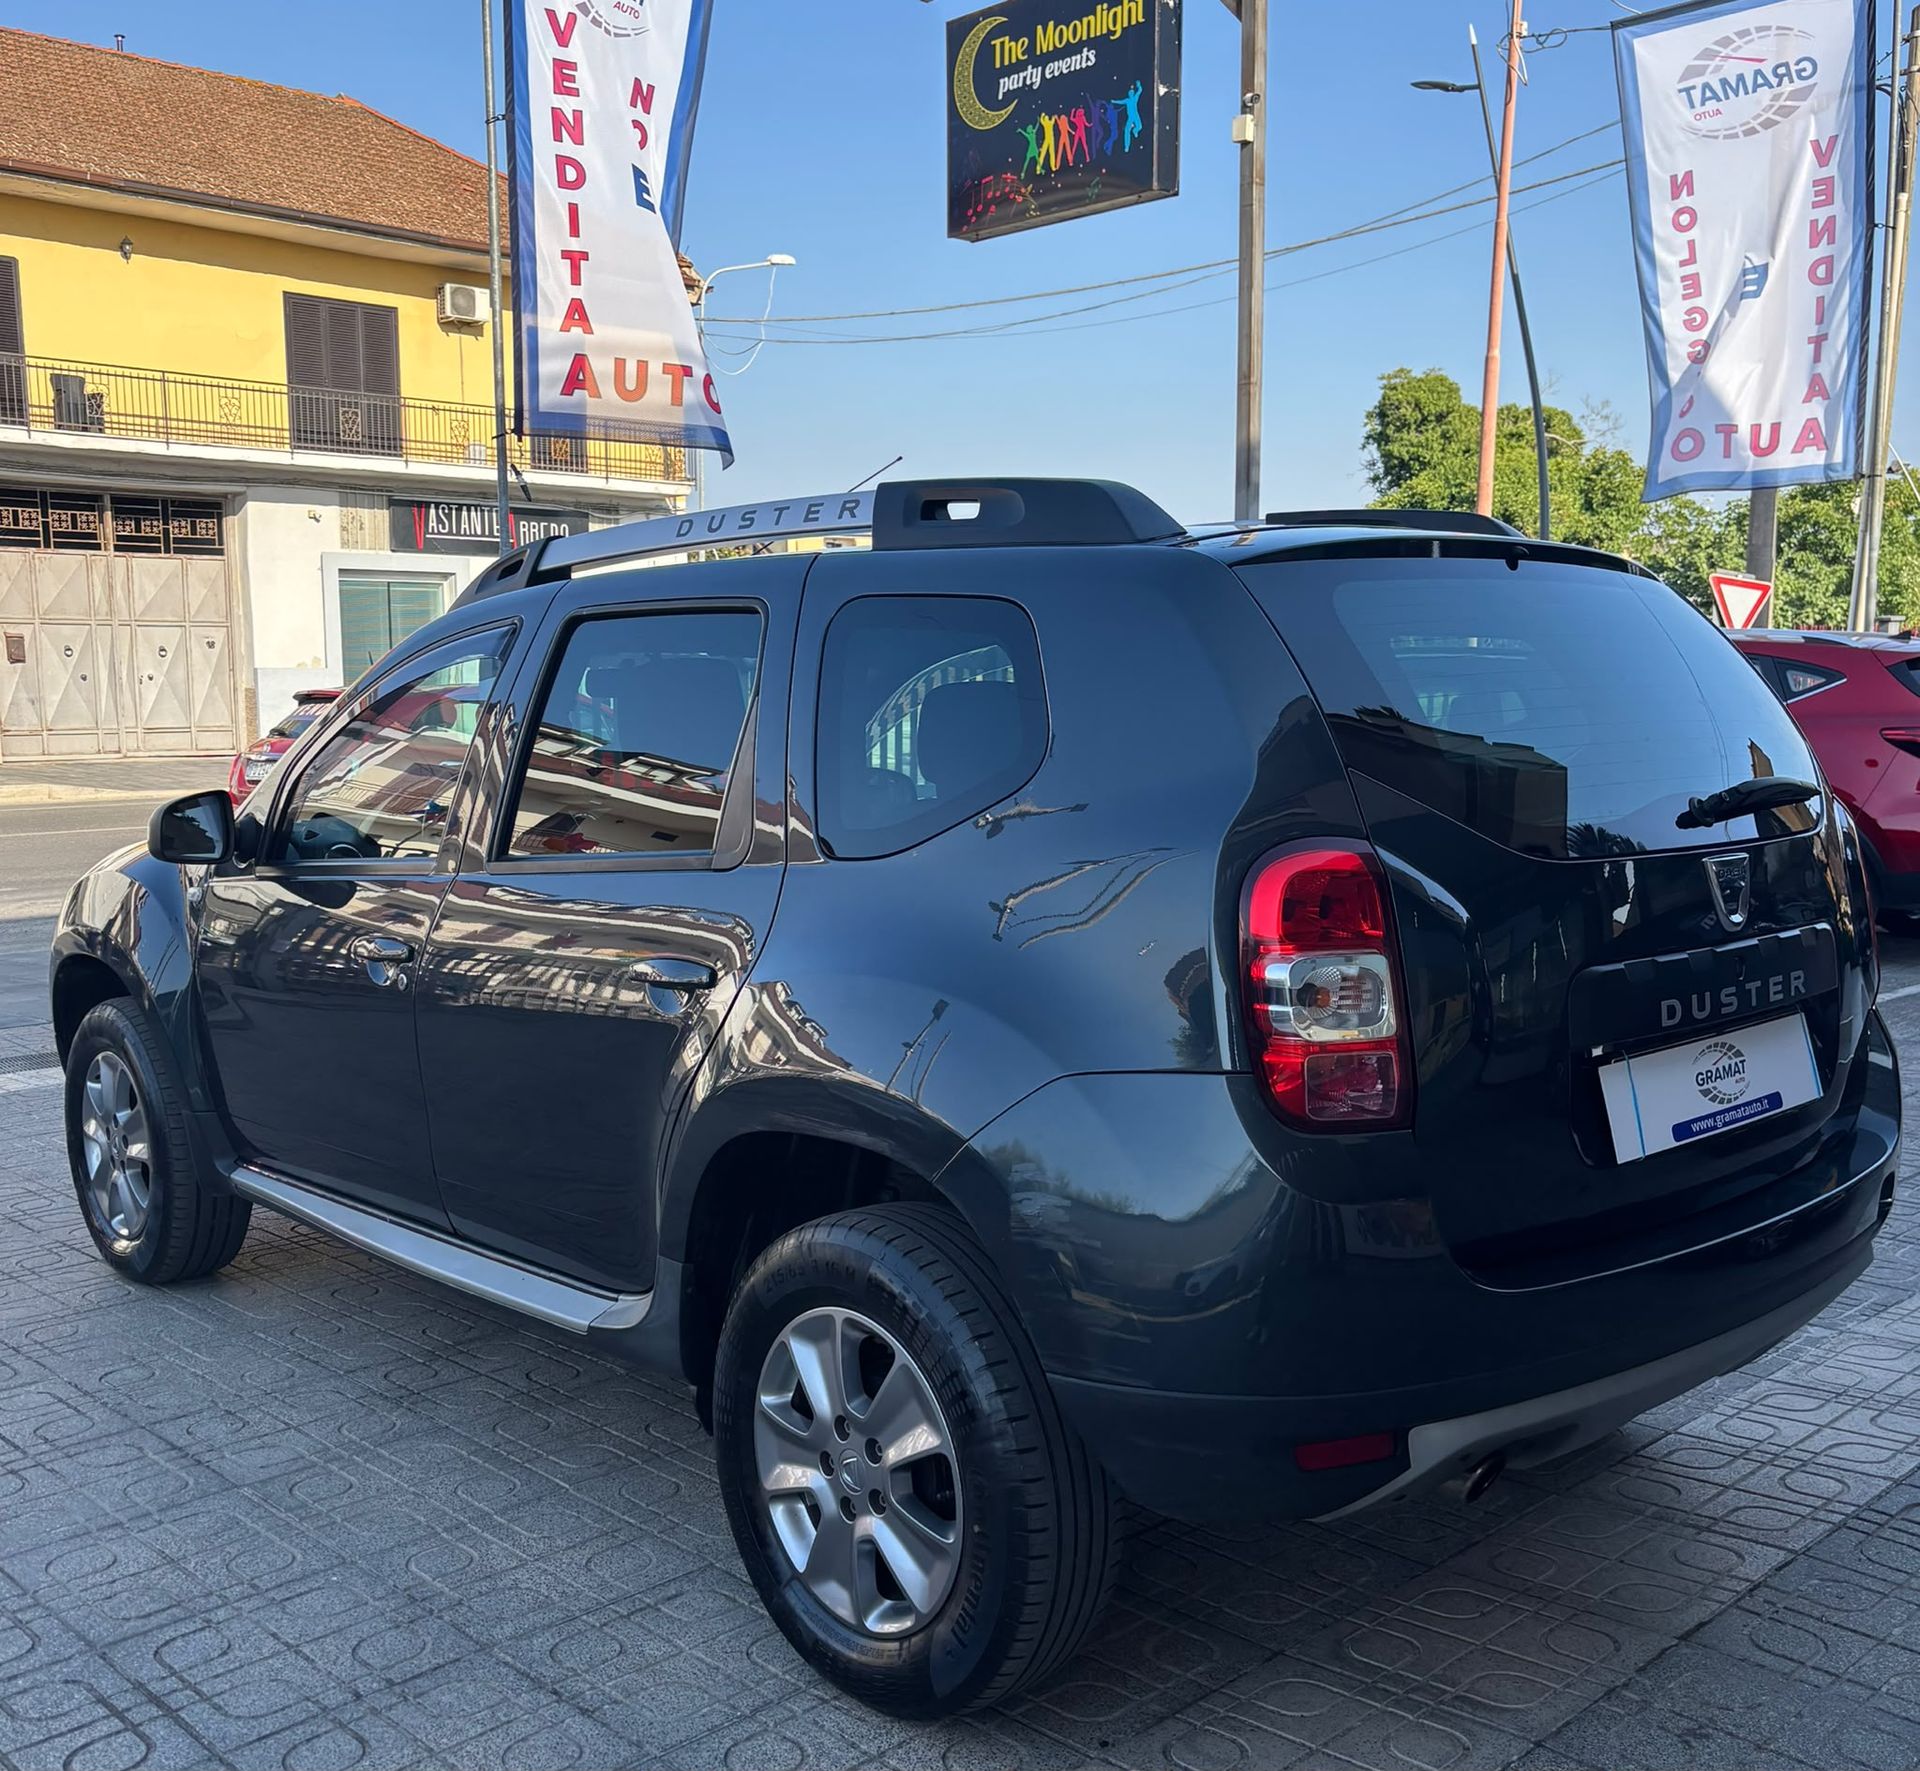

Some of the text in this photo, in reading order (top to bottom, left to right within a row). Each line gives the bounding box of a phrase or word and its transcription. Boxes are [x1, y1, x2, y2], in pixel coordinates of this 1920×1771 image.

[613, 1, 640, 20] AUTO
[991, 0, 1145, 69] The Moonlight
[998, 47, 1096, 100] party events
[545, 8, 594, 335] VENDITA
[560, 352, 722, 415] AUTO
[676, 499, 861, 538] DUSTER
[1660, 970, 1806, 1027] DUSTER
[1695, 1059, 1746, 1088] GRAMAT
[1691, 1098, 1769, 1134] www.gramatauto.it
